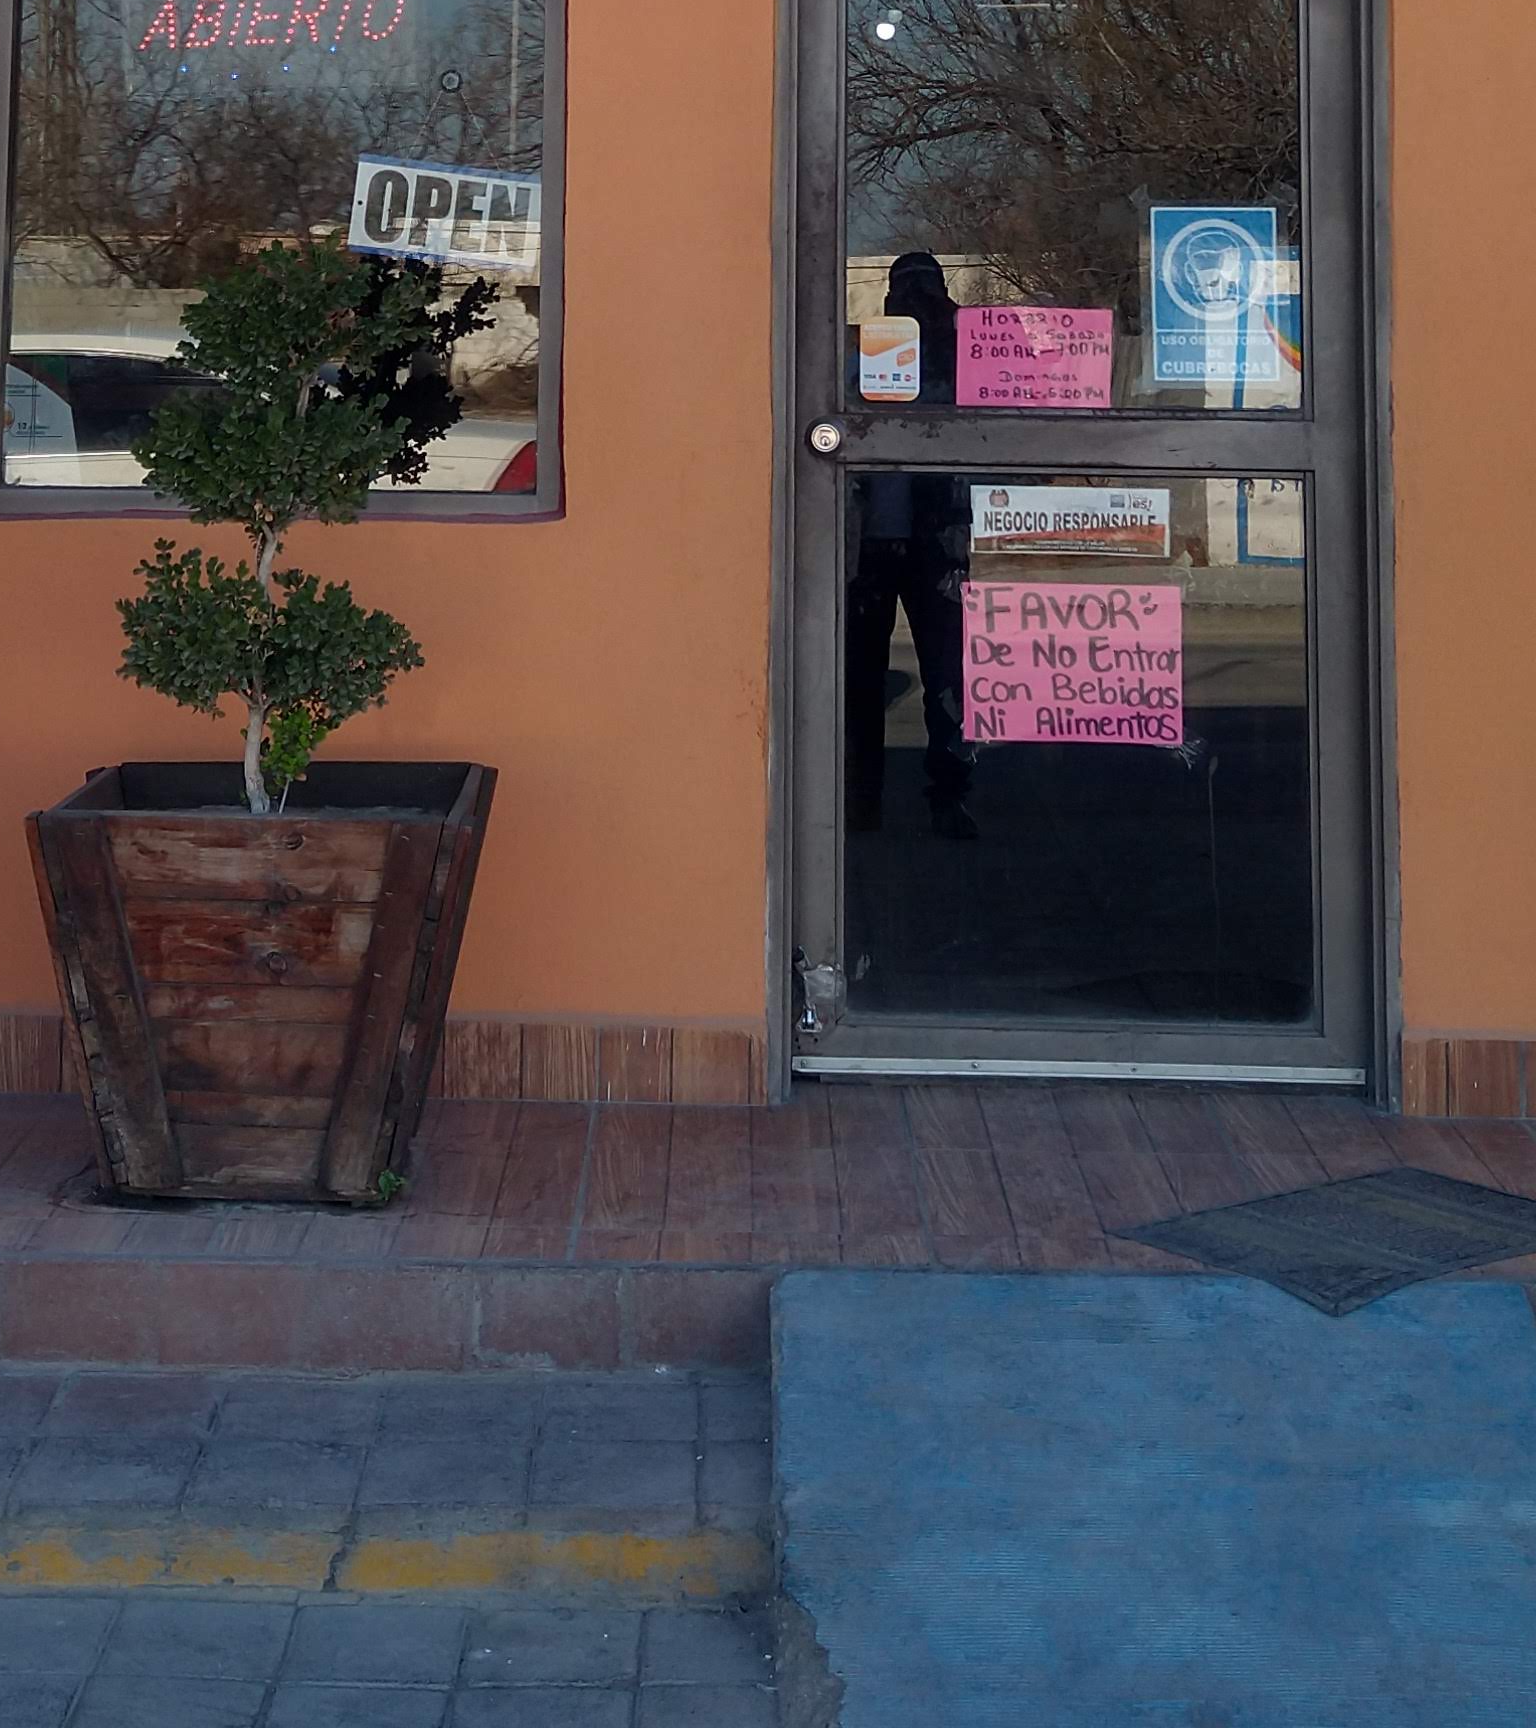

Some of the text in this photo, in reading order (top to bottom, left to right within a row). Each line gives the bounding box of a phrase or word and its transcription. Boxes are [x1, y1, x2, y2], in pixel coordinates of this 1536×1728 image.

[364, 169, 531, 259] OPEN
[970, 343, 1009, 359] 8:00
[1161, 335, 1186, 345] USO
[1161, 361, 1271, 374] CUBREBOCAS
[983, 511, 1048, 532] NEGOCIO
[1053, 513, 1157, 532] RESPONSABLE
[984, 586, 1140, 632] FAVOR
[971, 634, 1180, 672] De No Entrar
[1052, 674, 1180, 710] Bebidas
[974, 708, 1179, 741] Ni Alimentos
